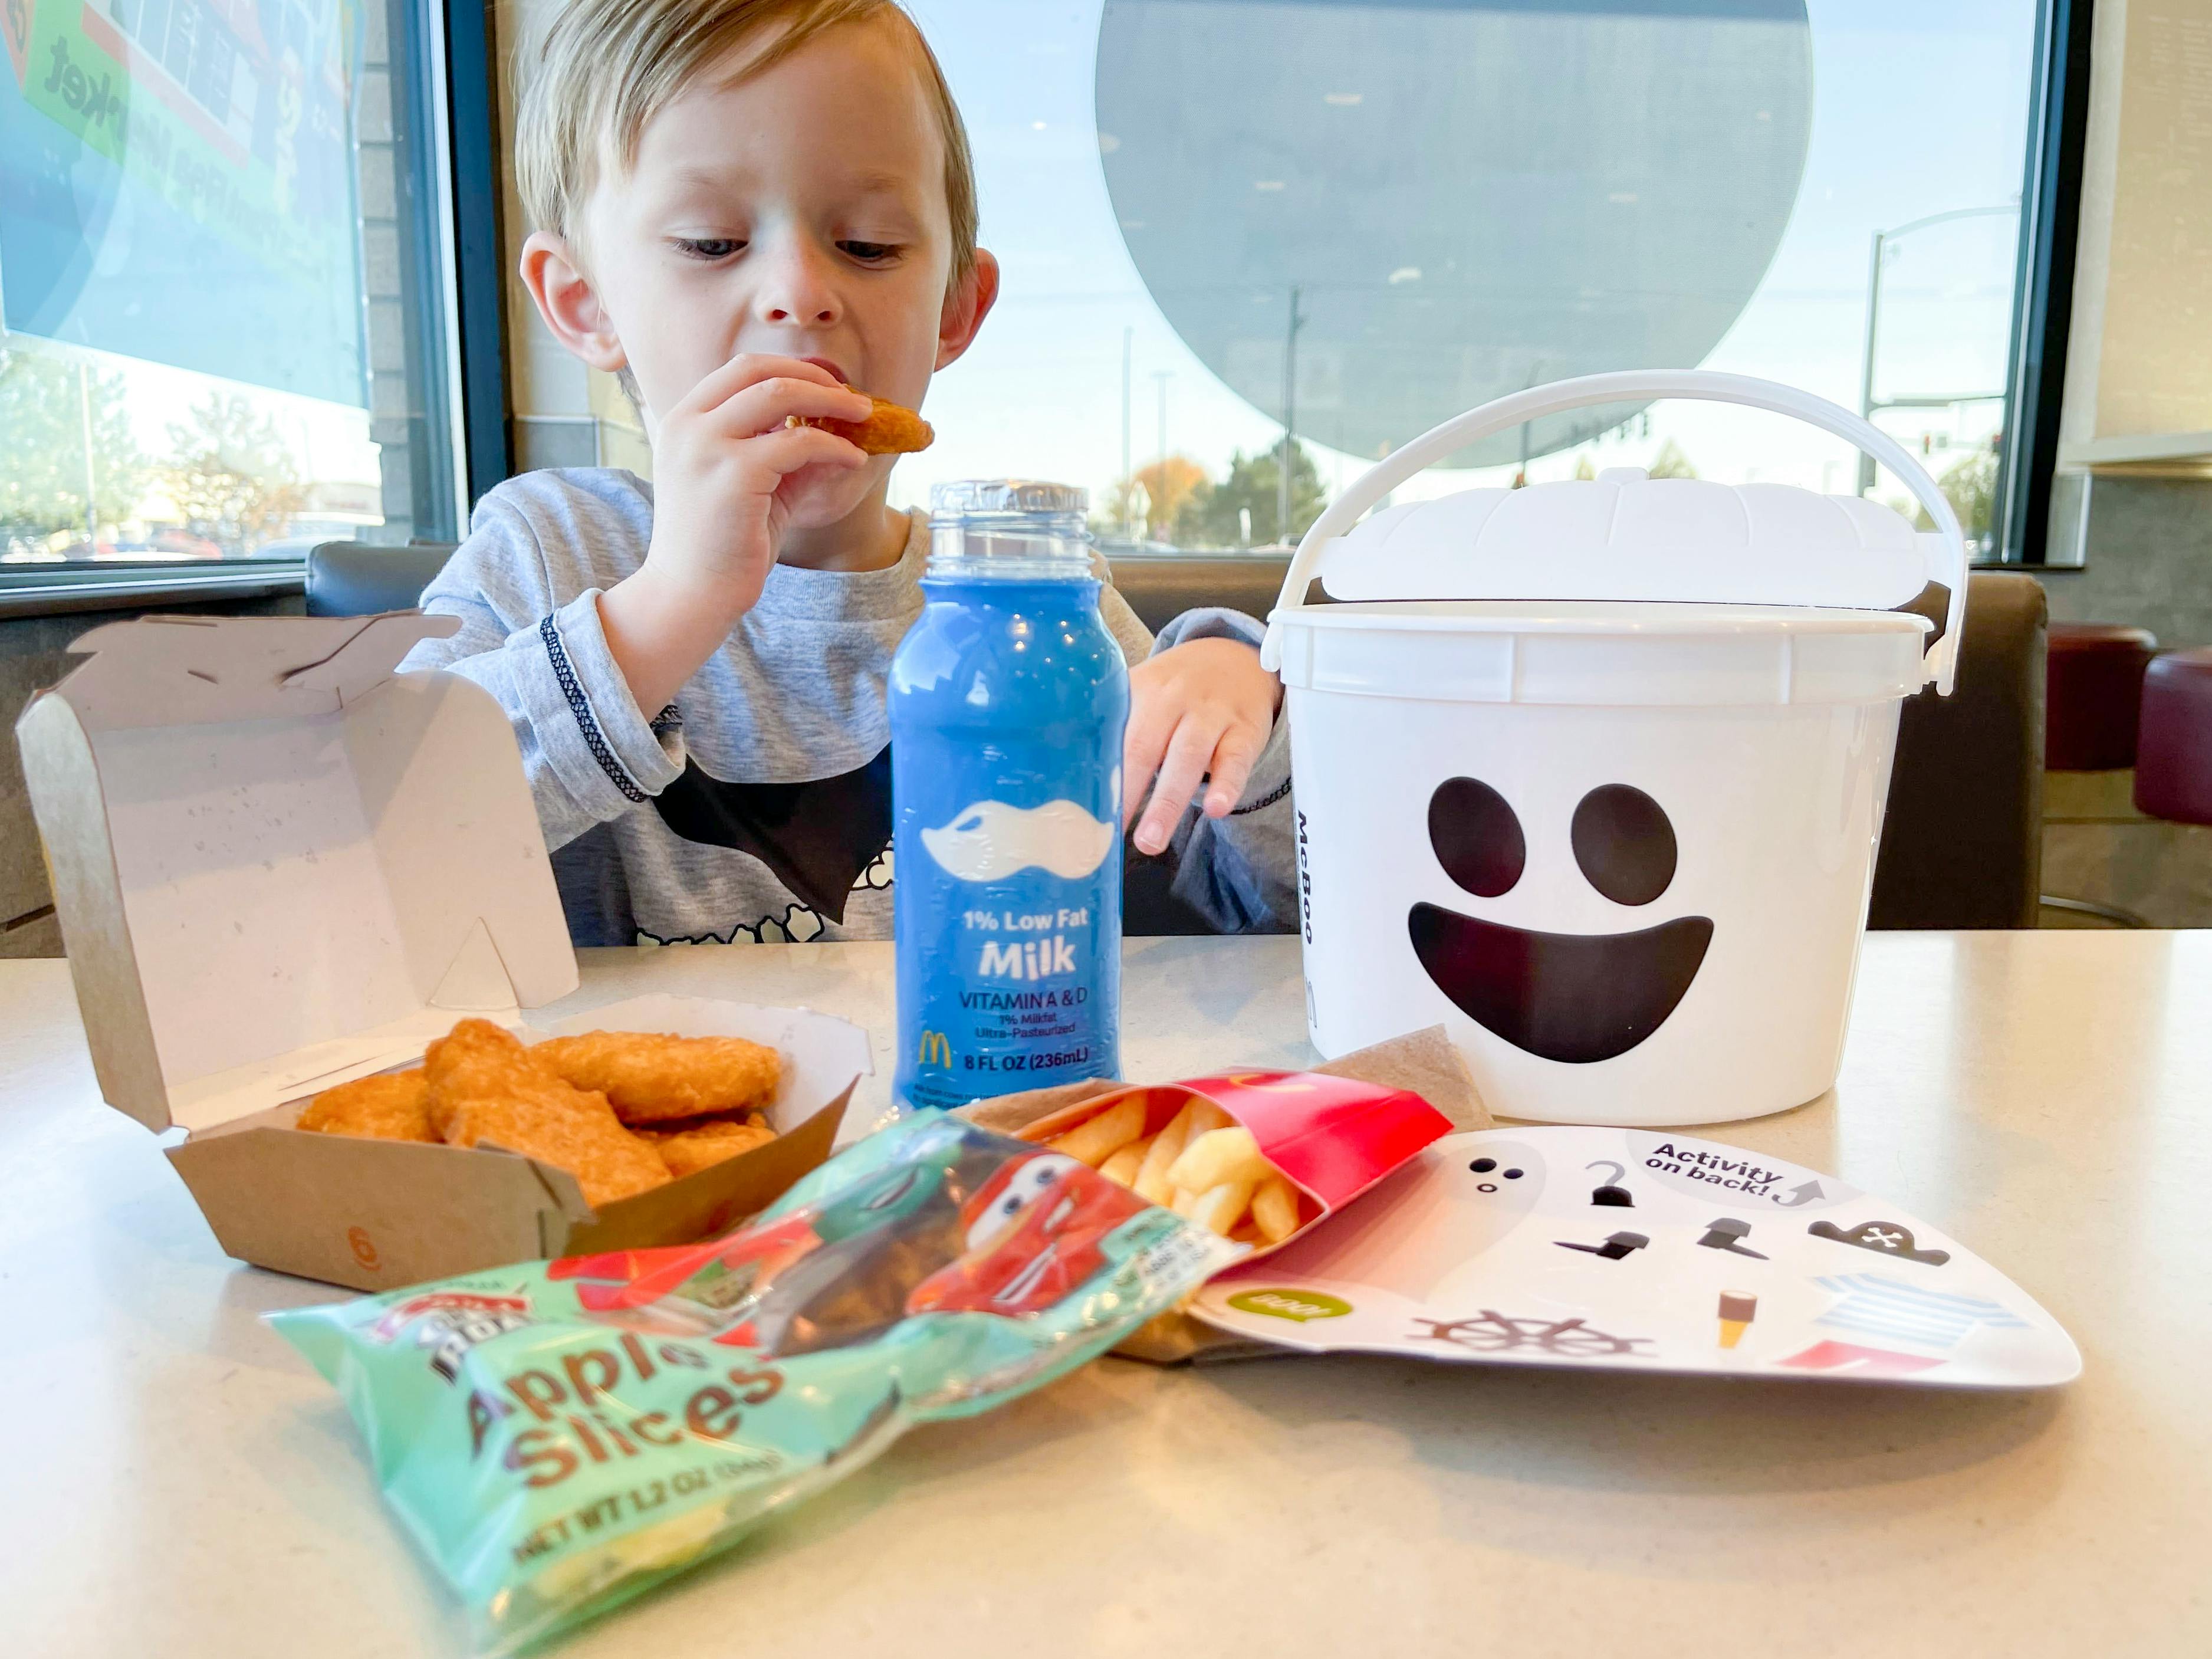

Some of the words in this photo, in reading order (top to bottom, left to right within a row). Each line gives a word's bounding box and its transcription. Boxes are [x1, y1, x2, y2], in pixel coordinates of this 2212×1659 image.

[1298, 810, 1312, 944] McBoo
[964, 910, 999, 931] 1%
[1005, 911, 1053, 931] Low
[1057, 907, 1088, 928] Fat
[978, 935, 1076, 981] Milk
[959, 991, 1043, 1010] VITAMIN
[1047, 991, 1058, 1007] A
[1062, 990, 1073, 1006] &
[1077, 987, 1088, 1003] D
[976, 1022, 1076, 1039] Ultra-Pasteurized
[1000, 1014, 1018, 1025] 1%
[1021, 1012, 1057, 1024] Milkfat
[964, 1056, 974, 1070] 8
[979, 1056, 998, 1071] FL
[1004, 1056, 1026, 1070] OZ
[1030, 1046, 1089, 1070] (236mL)
[1645, 1158, 1682, 1174] on
[1687, 1166, 1771, 1197] back!
[1652, 1143, 1784, 1184] Activity
[349, 1226, 377, 1263] 6
[468, 1330, 709, 1460] Apple
[575, 1493, 623, 1529] WT
[670, 1467, 712, 1496] OZ
